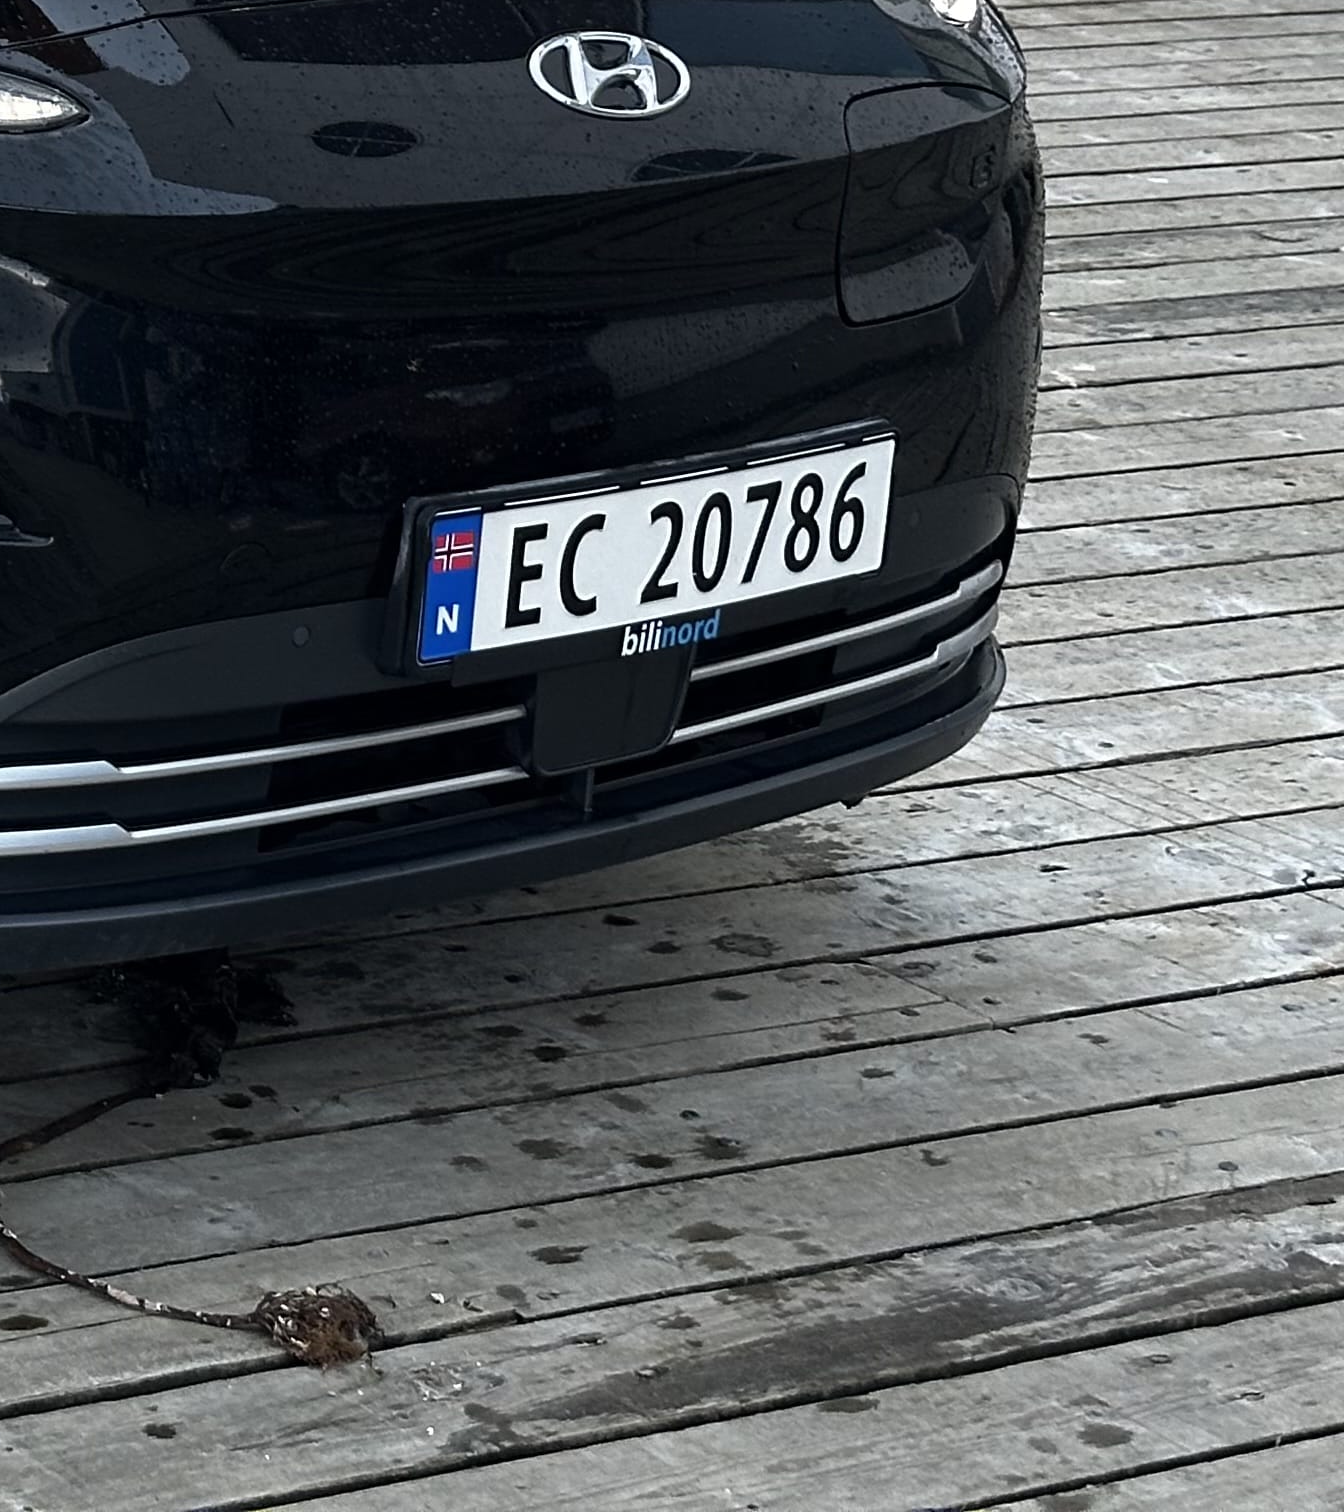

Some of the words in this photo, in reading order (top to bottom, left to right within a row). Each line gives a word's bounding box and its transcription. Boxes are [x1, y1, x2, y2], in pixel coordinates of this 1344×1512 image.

[505, 513, 607, 629] EC
[639, 461, 867, 605] 20786
[436, 603, 460, 636] N
[620, 608, 721, 657] bilinord
